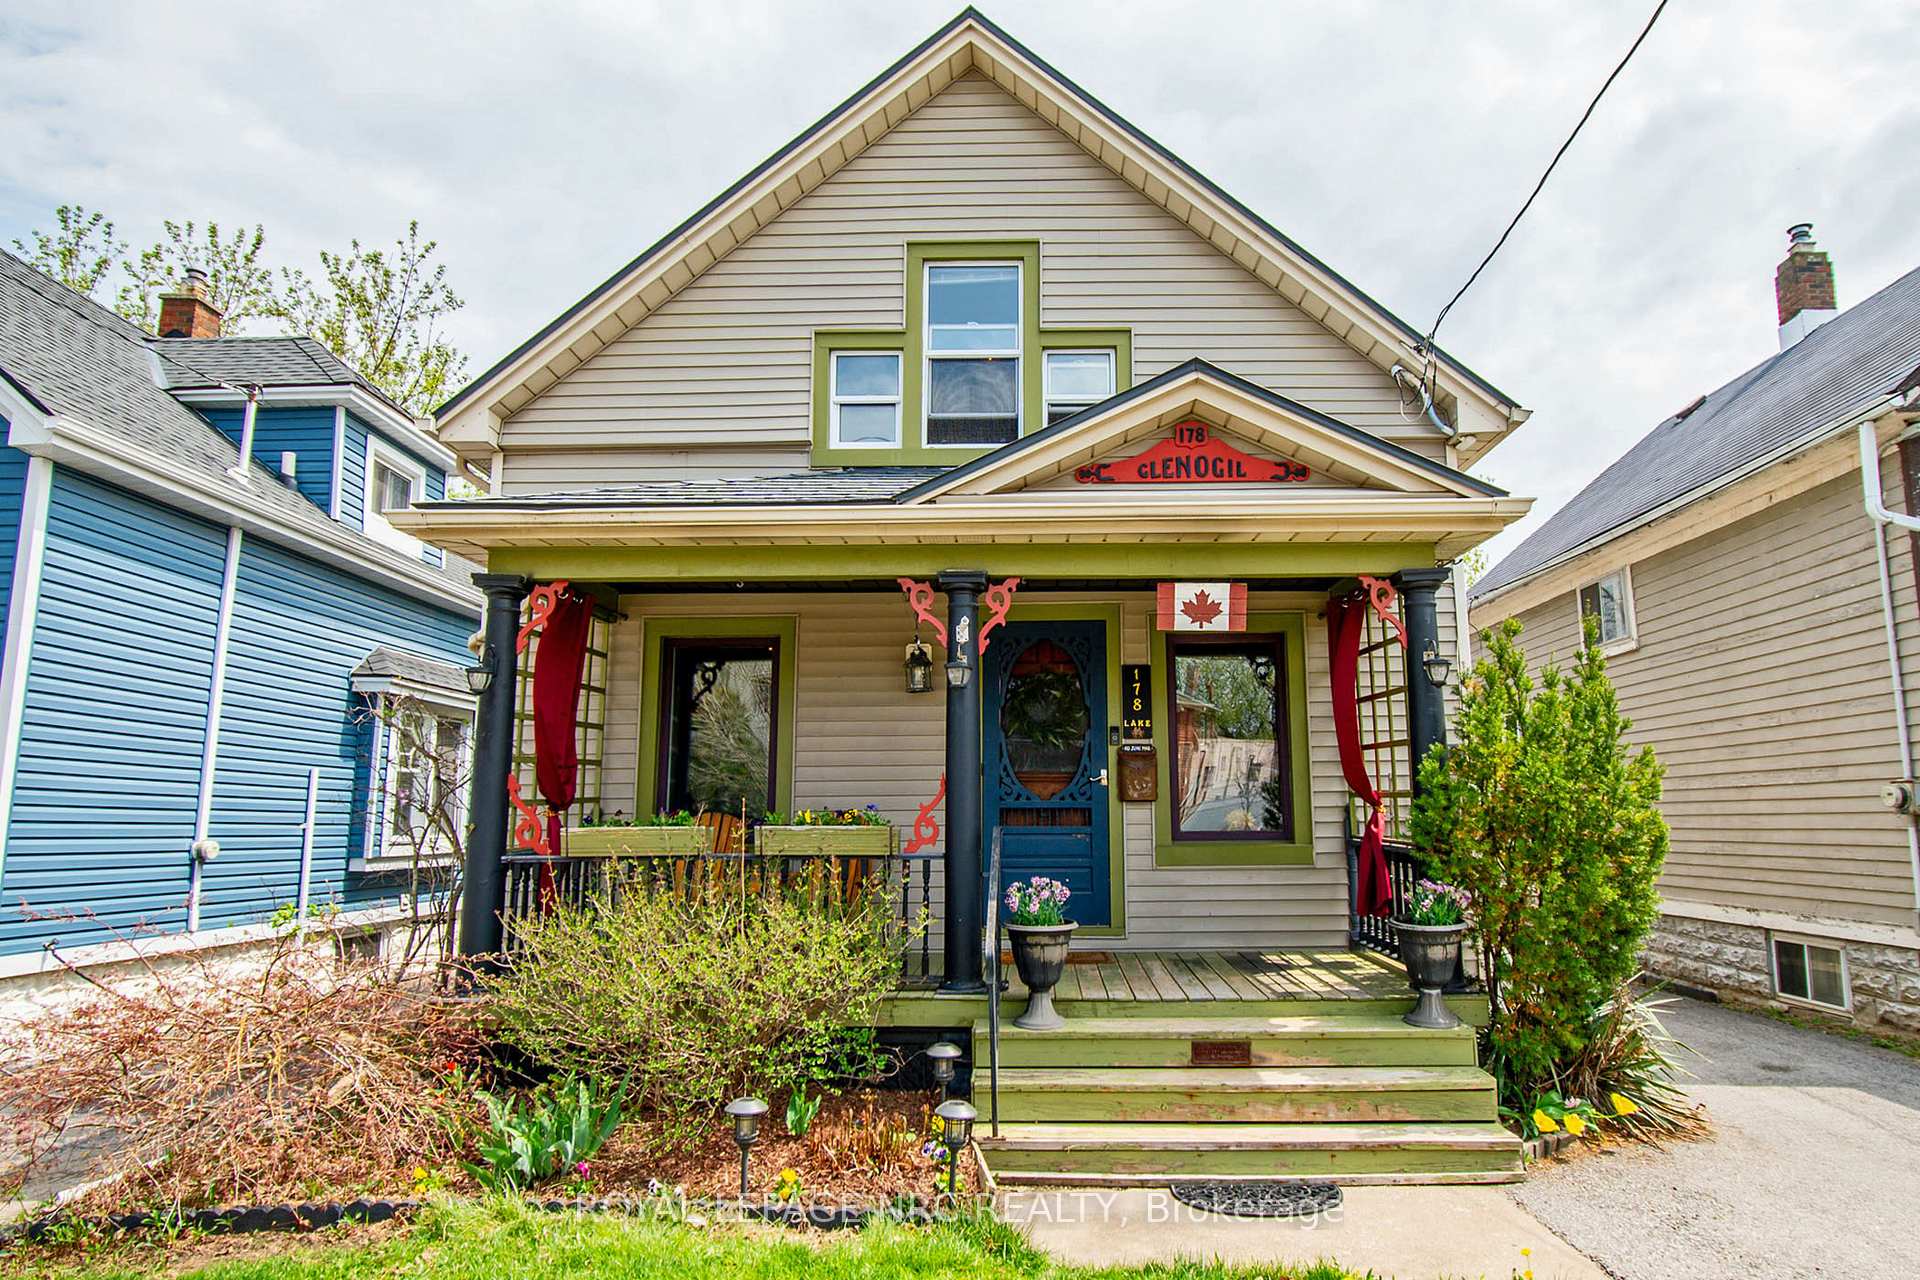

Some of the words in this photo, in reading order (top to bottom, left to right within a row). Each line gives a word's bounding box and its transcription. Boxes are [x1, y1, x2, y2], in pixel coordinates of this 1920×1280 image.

[1179, 427, 1206, 444] 178
[1137, 455, 1248, 479] GLENOGIL
[1124, 719, 1151, 727] LAKE
